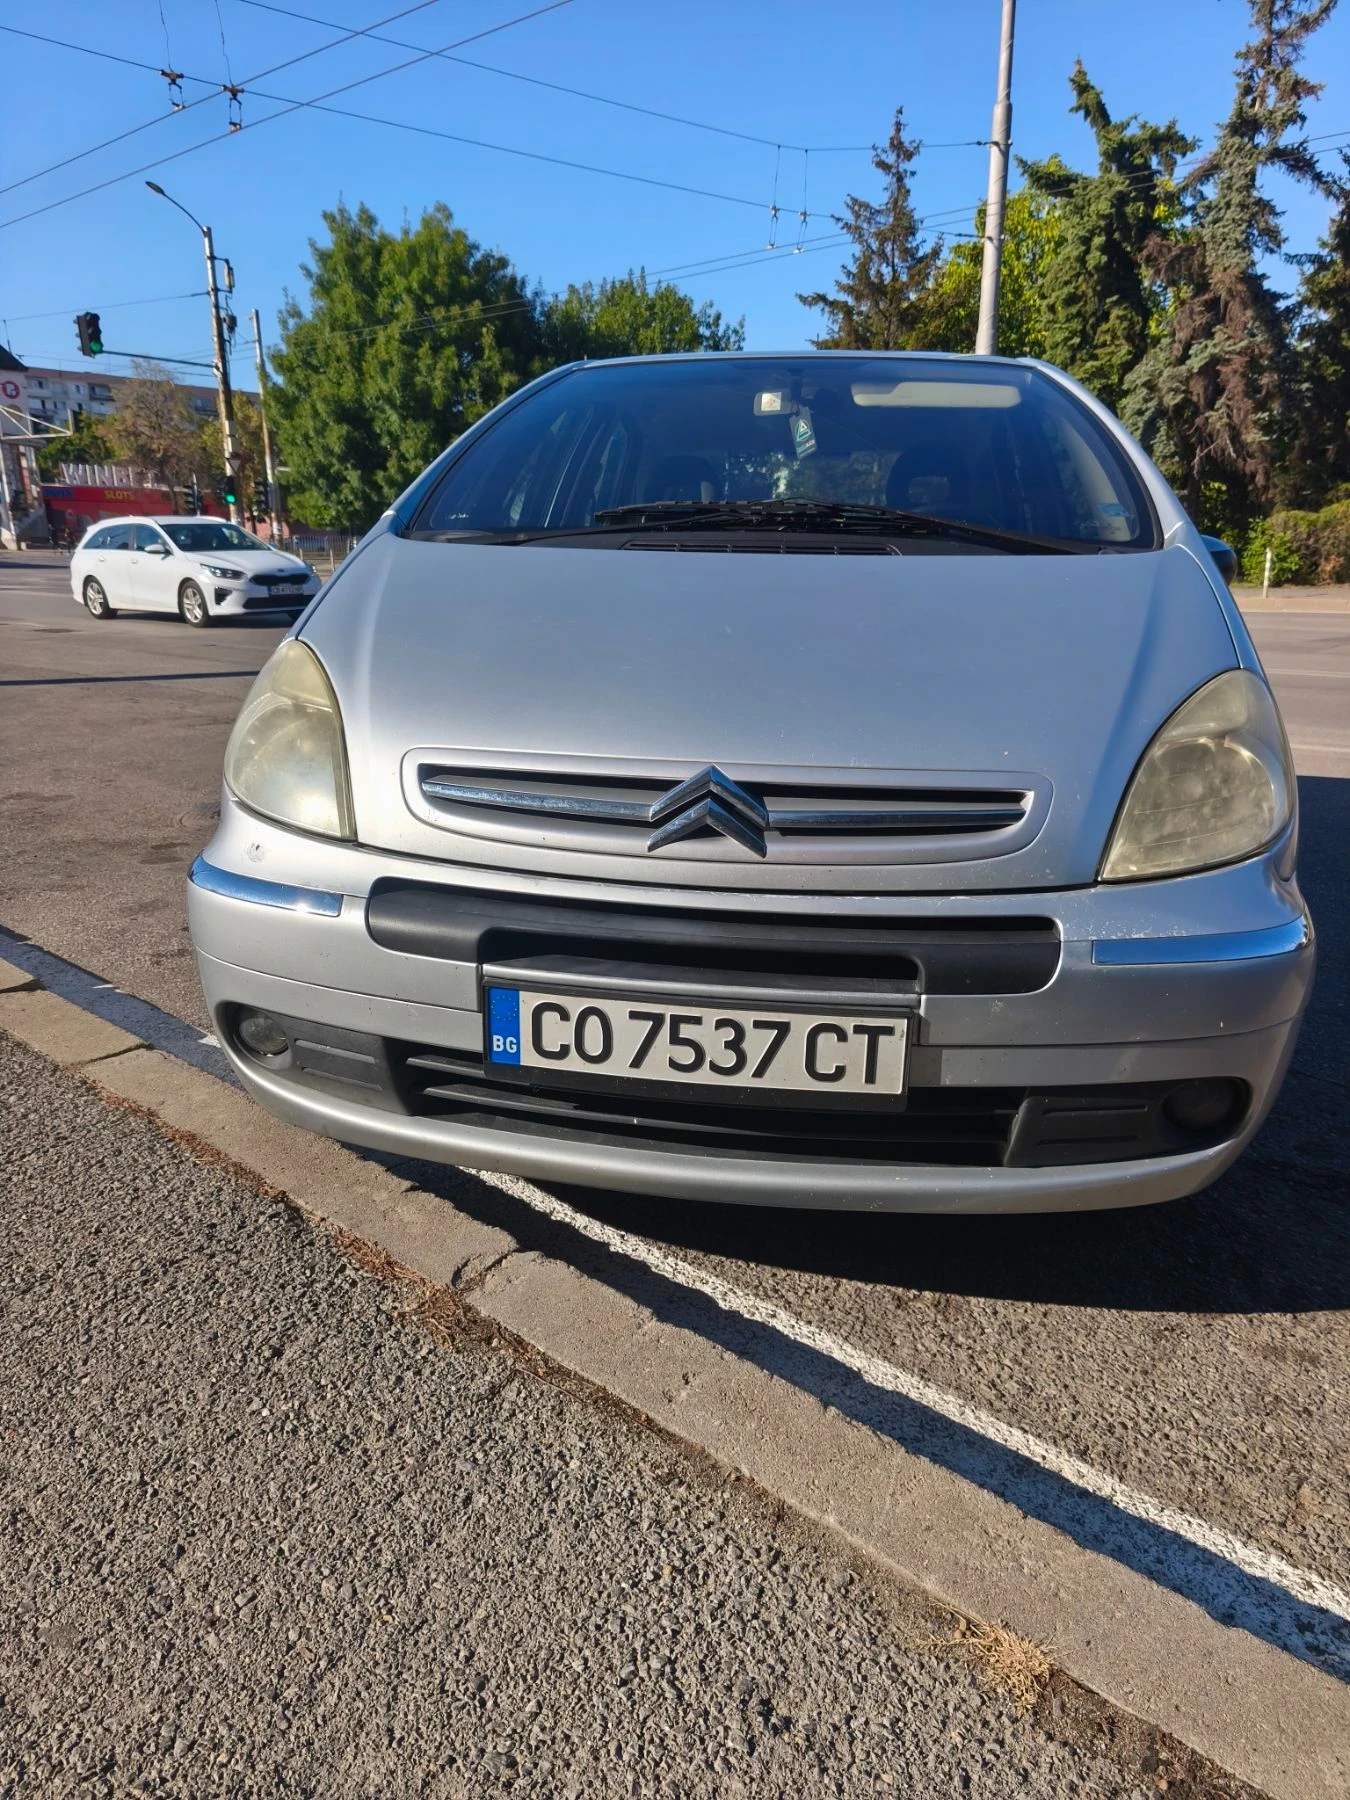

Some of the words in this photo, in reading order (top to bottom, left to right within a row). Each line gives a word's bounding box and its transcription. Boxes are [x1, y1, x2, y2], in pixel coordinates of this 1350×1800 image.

[104, 490, 134, 500] SLOTS
[492, 1034, 518, 1054] BG
[628, 1009, 791, 1079] 7537
[804, 1022, 896, 1085] CT
